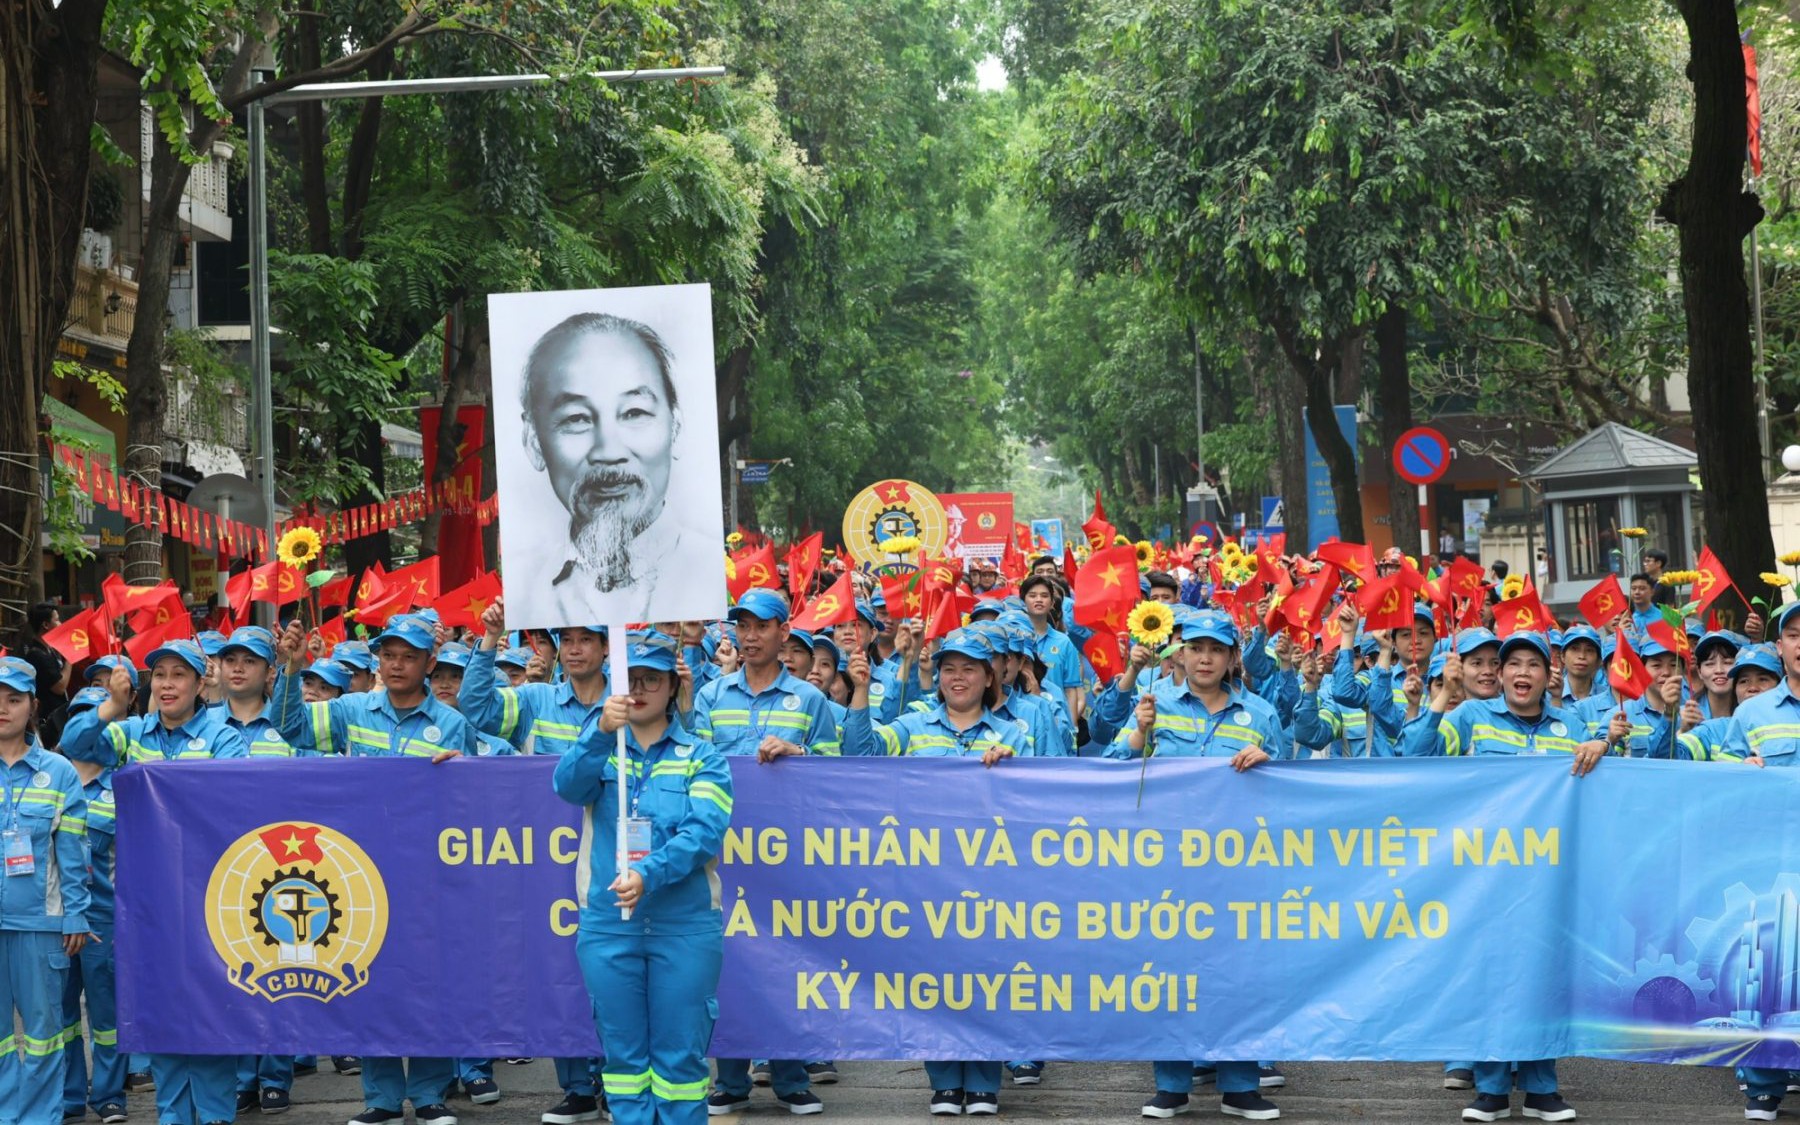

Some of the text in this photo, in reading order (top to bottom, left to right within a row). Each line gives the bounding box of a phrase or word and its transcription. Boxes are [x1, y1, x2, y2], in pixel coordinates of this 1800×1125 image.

[438, 827, 533, 865] GIAI
[723, 827, 788, 865] NG
[804, 816, 941, 866] NHÂN
[955, 816, 1018, 867] VÀ
[1031, 816, 1164, 867] CÔNG
[1179, 816, 1314, 867] ĐOÀN
[1328, 816, 1438, 878] VIỆT
[1452, 828, 1560, 866] NAM
[724, 885, 1449, 940] Ả NƯỚC VỮNG BƯỚC TIẾN VÀO
[267, 972, 330, 993] CĐVN
[796, 958, 1198, 1012] KỶ NGUYÊN MỚI!
